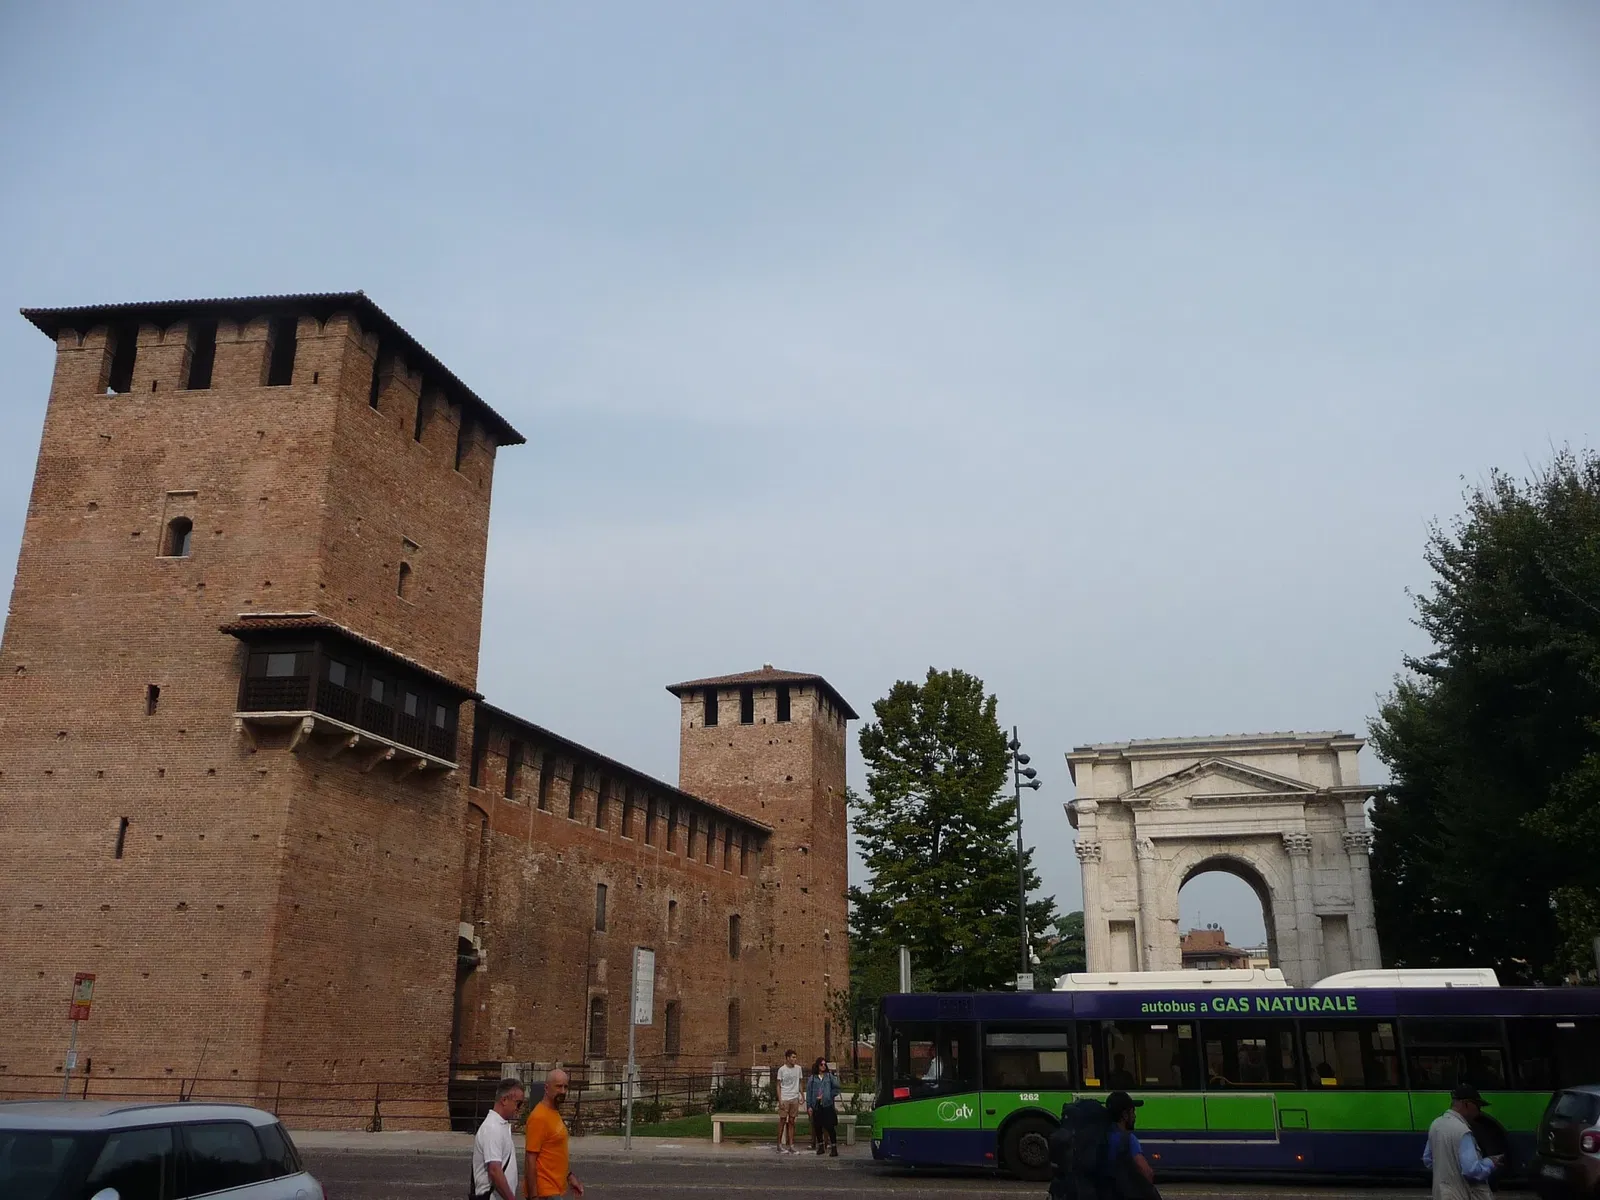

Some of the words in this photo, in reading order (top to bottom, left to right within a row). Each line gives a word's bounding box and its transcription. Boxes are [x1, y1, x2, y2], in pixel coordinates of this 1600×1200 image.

[1141, 1000, 1196, 1012] autobus
[1200, 1002, 1208, 1012] a
[1212, 997, 1250, 1012] GAS
[1256, 996, 1358, 1011] NATURALE
[1019, 1093, 1039, 1101] 1262
[955, 1103, 973, 1119] atv
